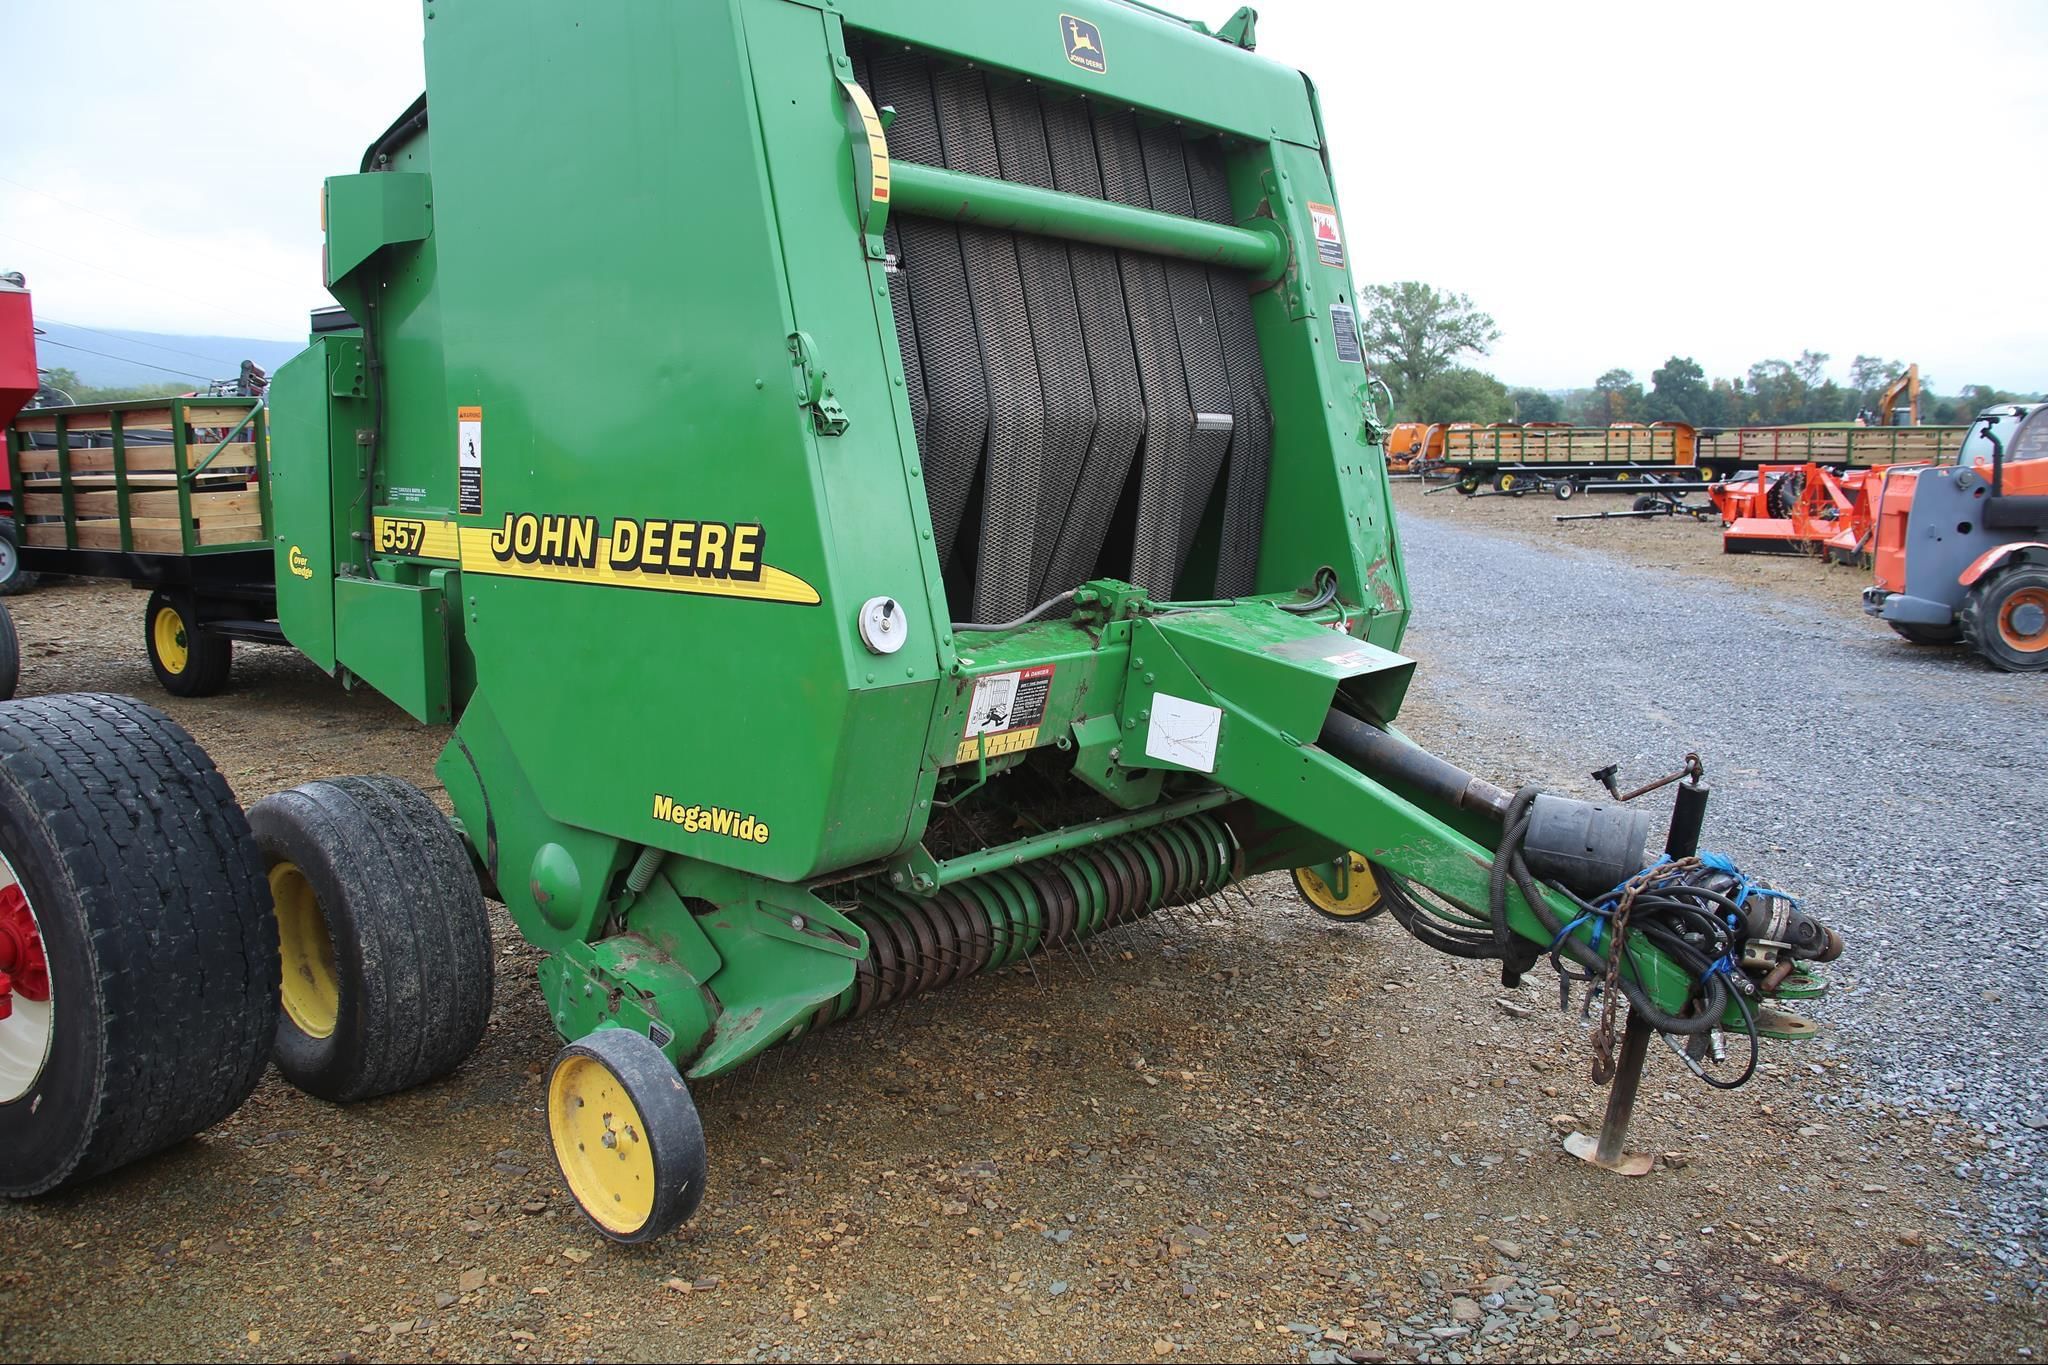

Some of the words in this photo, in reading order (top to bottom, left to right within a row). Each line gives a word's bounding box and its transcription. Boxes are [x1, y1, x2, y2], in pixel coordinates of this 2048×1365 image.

[1070, 54, 1085, 64] JOHN
[1086, 58, 1103, 69] DEERE
[383, 519, 425, 556] 557
[491, 512, 599, 568] JOHN
[609, 517, 766, 582] DEERE
[653, 793, 769, 844] MegaWide
